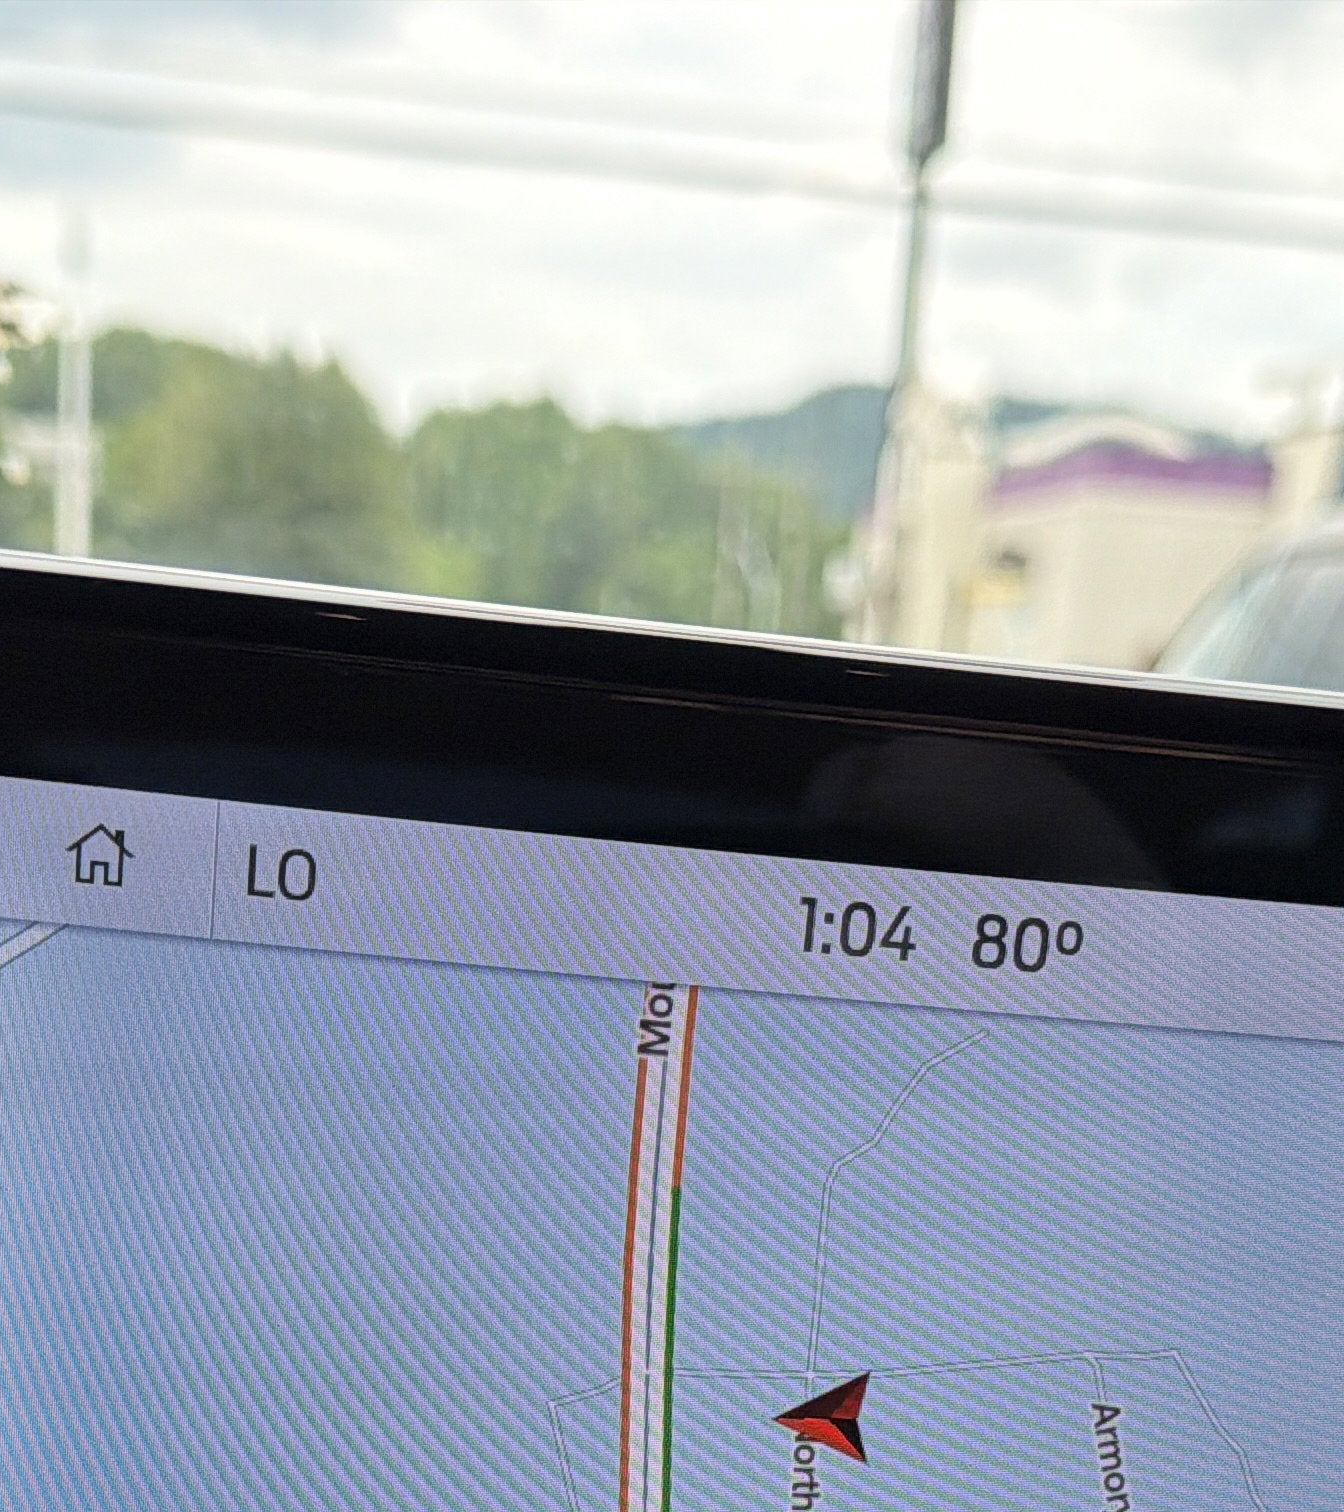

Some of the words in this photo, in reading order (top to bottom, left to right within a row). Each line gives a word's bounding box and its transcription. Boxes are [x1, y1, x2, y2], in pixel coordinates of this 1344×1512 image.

[247, 844, 316, 901] LO
[800, 897, 917, 961] 1:04
[637, 983, 676, 1056] Mo
